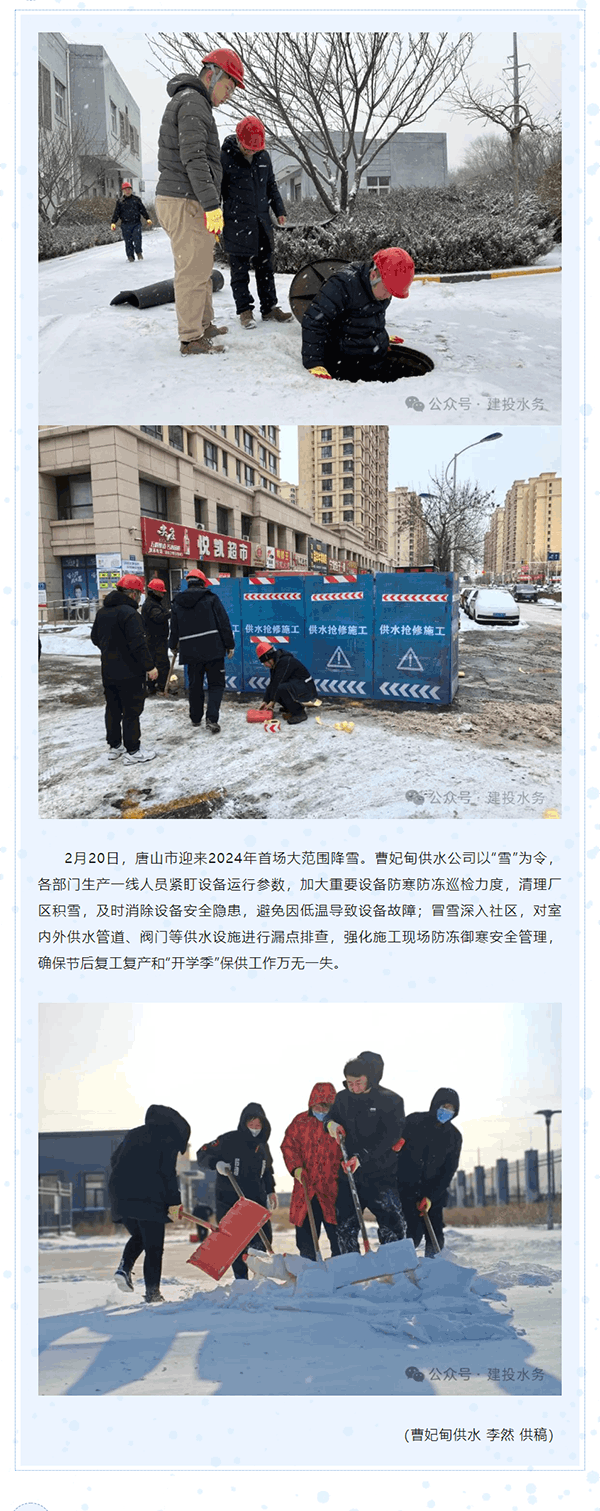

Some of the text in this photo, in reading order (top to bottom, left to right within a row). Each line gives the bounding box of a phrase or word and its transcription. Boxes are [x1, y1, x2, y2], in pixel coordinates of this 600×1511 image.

[197, 534, 248, 561] 悦凯超市
[245, 623, 300, 635] 供水抢修施工
[308, 624, 368, 636] 供水抢修施工
[379, 624, 446, 636] 供水抢修施工
